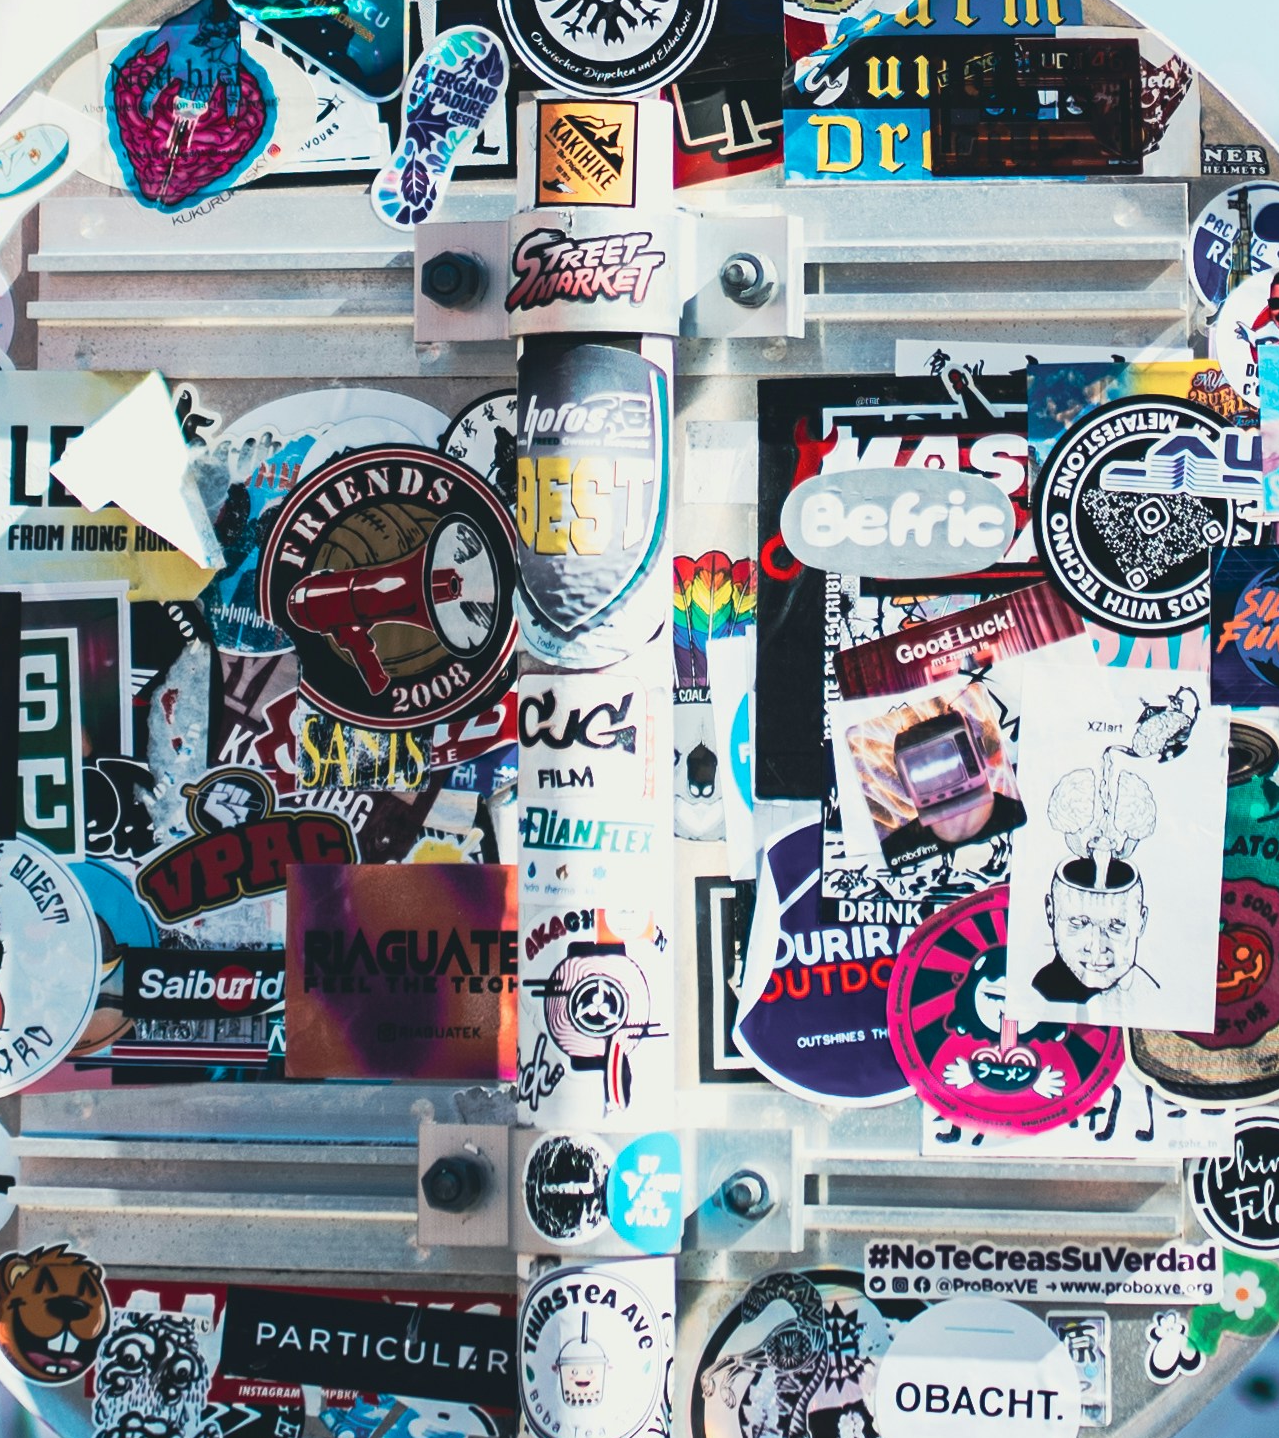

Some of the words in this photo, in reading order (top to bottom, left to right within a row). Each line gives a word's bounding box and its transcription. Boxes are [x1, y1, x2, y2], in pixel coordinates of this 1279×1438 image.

[549, 117, 618, 191] KAKIHIKE
[530, 251, 665, 306] MARKET
[280, 466, 455, 570] FRIENDS
[8, 524, 64, 552] FROM
[71, 524, 127, 552] HONG
[896, 631, 954, 665] Good
[956, 609, 1017, 647] Luck!
[391, 661, 473, 714] 2008
[537, 765, 595, 789] FILM
[150, 820, 345, 913] VPAC
[303, 976, 371, 995] FEEL
[388, 976, 438, 995] THE
[797, 1028, 866, 1049] OUTSHINES
[977, 1062, 1032, 1083] ラーメン
[868, 1242, 1217, 1274] #NoTeCreasSuVerdad
[935, 1277, 1038, 1296] @ProBoxVE
[1060, 1279, 1213, 1297] www.proboxve.org
[238, 1385, 301, 1400] INSTAGRAM
[894, 1382, 1065, 1422] OBACHT.
